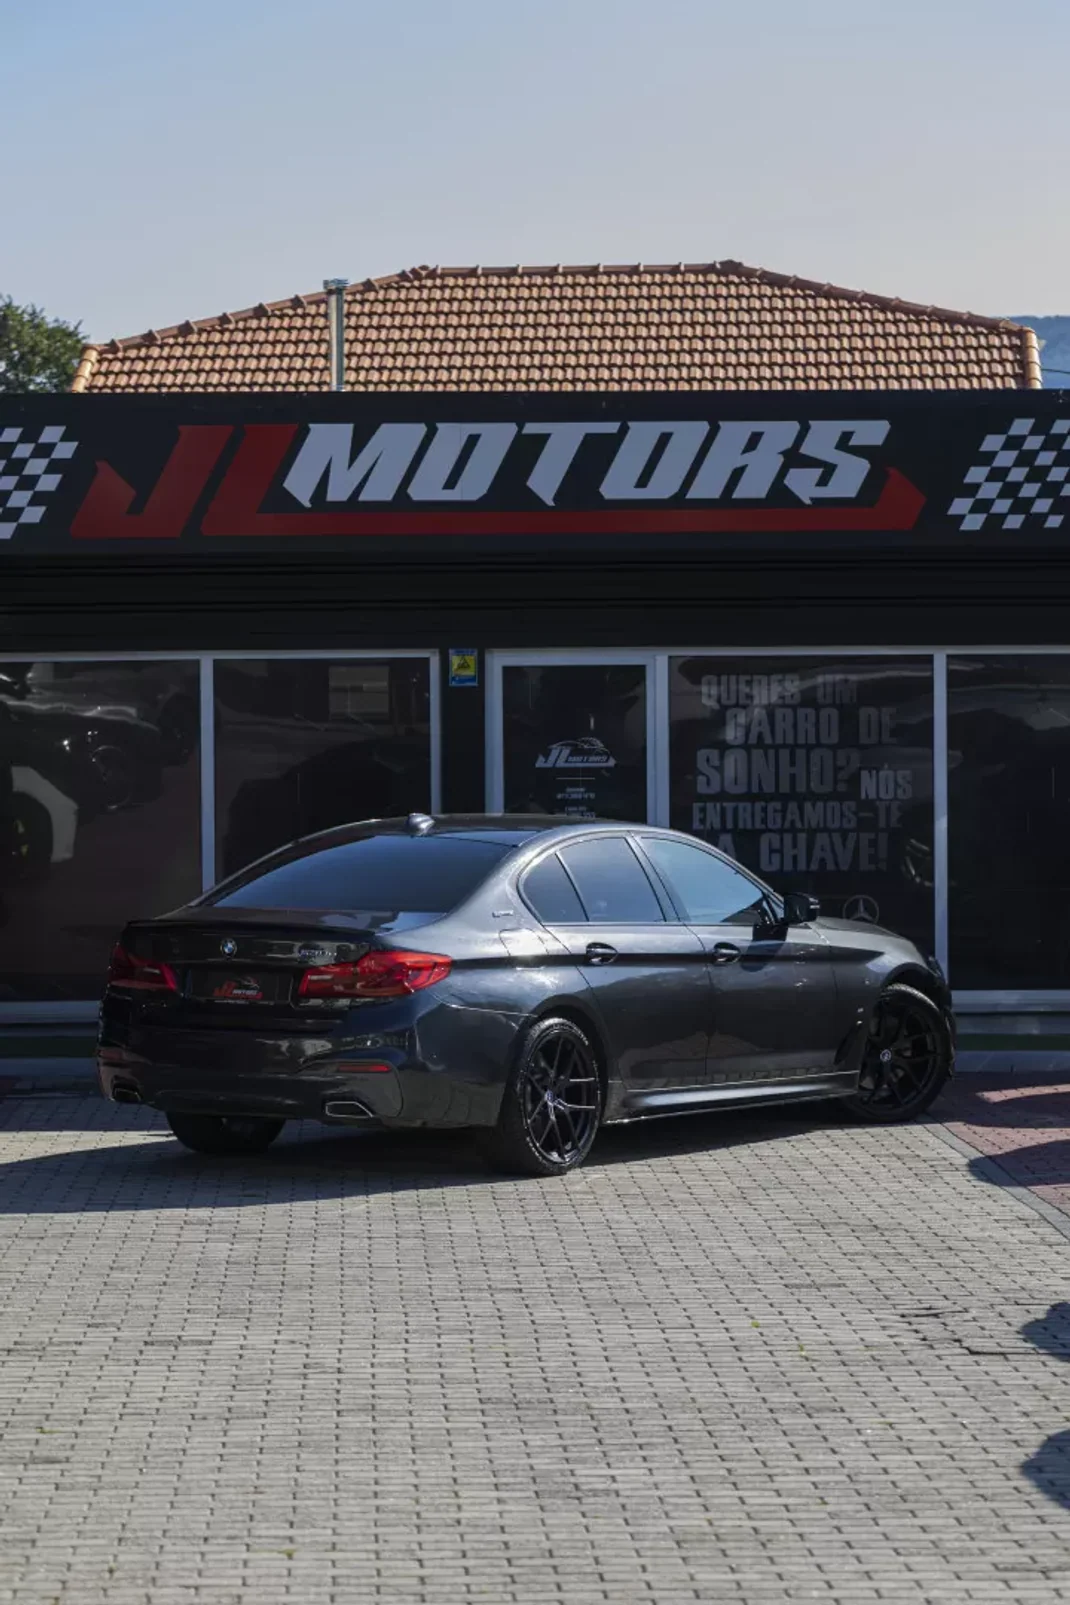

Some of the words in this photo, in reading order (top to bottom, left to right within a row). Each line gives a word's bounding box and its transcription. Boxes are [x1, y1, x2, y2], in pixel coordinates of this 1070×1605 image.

[282, 420, 891, 507] MOTORS
[701, 674, 801, 709] QUERES
[725, 707, 839, 745] CARRO
[858, 707, 898, 745] DE
[696, 747, 861, 795] SONHO?
[860, 763, 913, 800] NÓS
[692, 801, 904, 830] ENTREGAMOS-TE
[759, 832, 889, 872] CHAVE!
